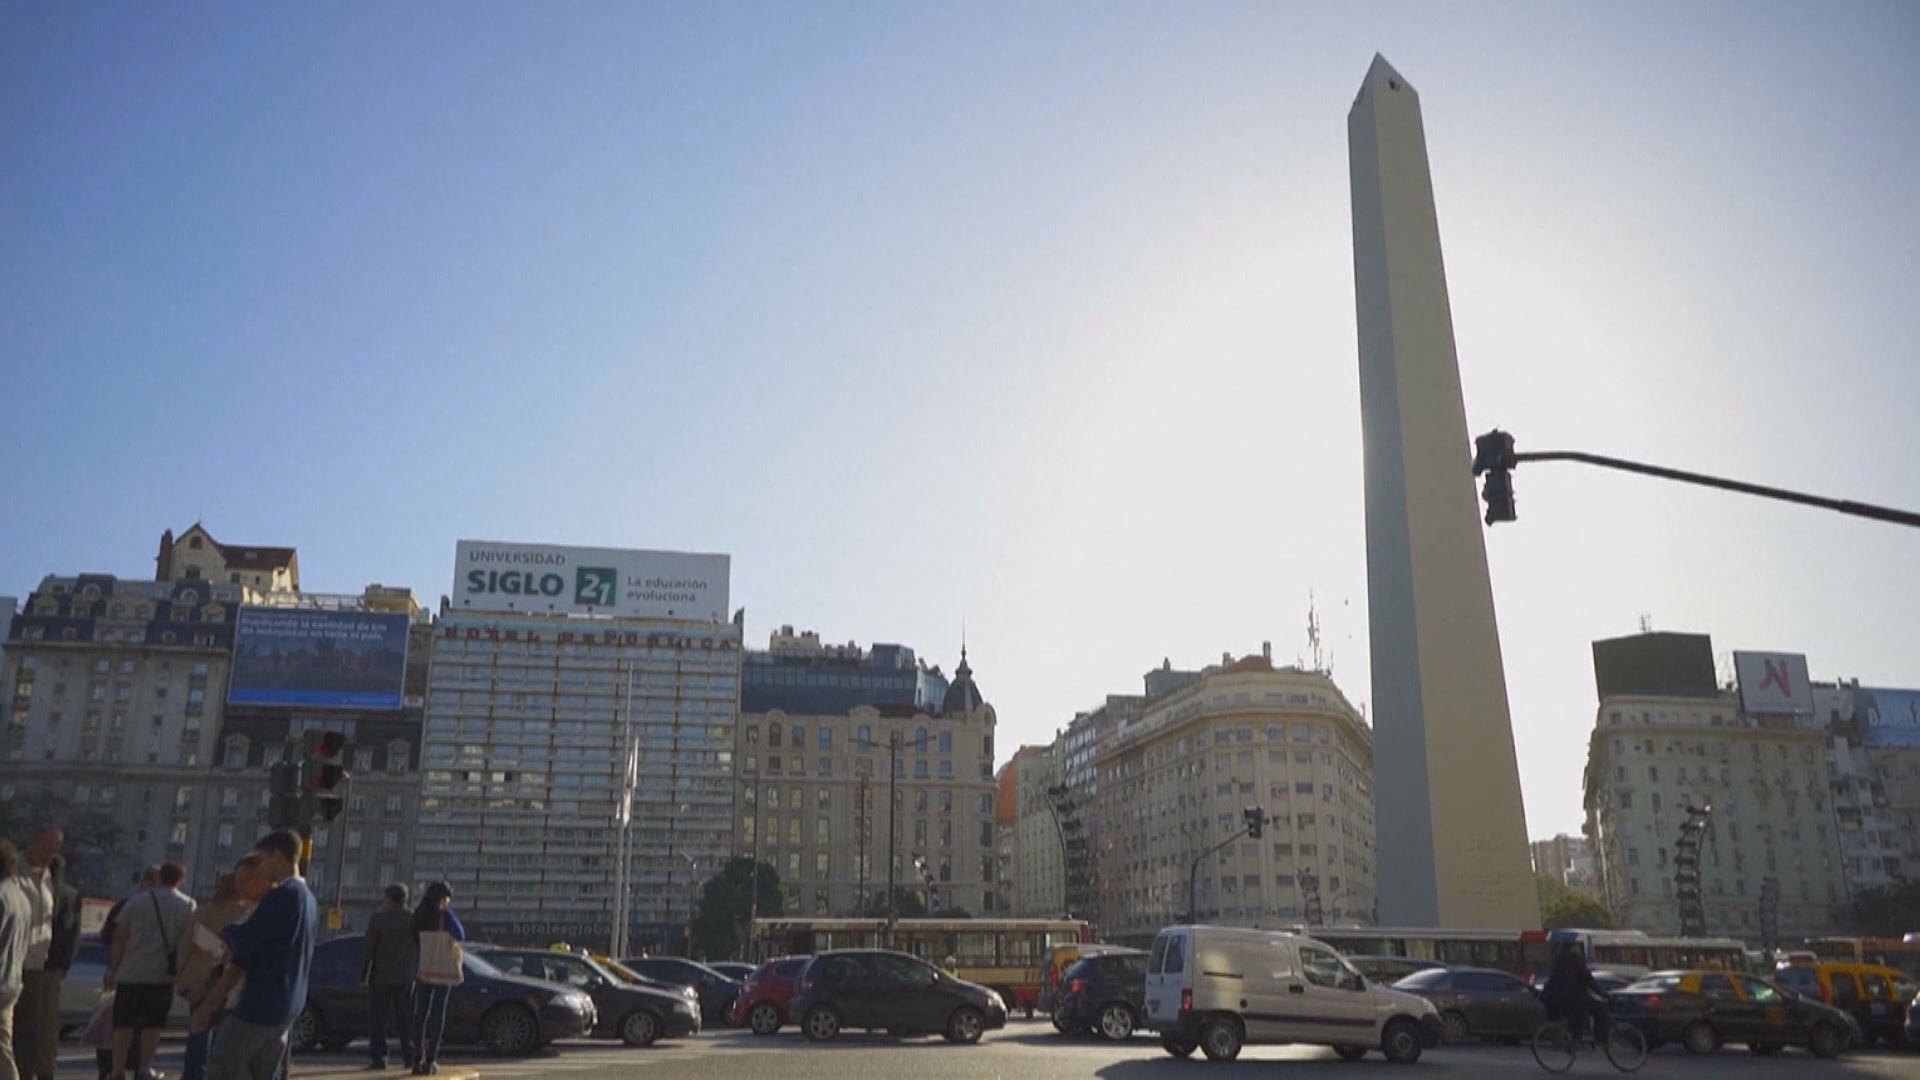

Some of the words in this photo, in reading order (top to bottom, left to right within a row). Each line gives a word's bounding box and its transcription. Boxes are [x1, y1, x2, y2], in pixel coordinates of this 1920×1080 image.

[469, 550, 566, 565] UNIVERSIDAD
[467, 569, 564, 597] SIGLO
[580, 574, 611, 604] 21
[626, 576, 641, 586] La
[645, 577, 707, 590] educación
[626, 589, 696, 603] evoluciona
